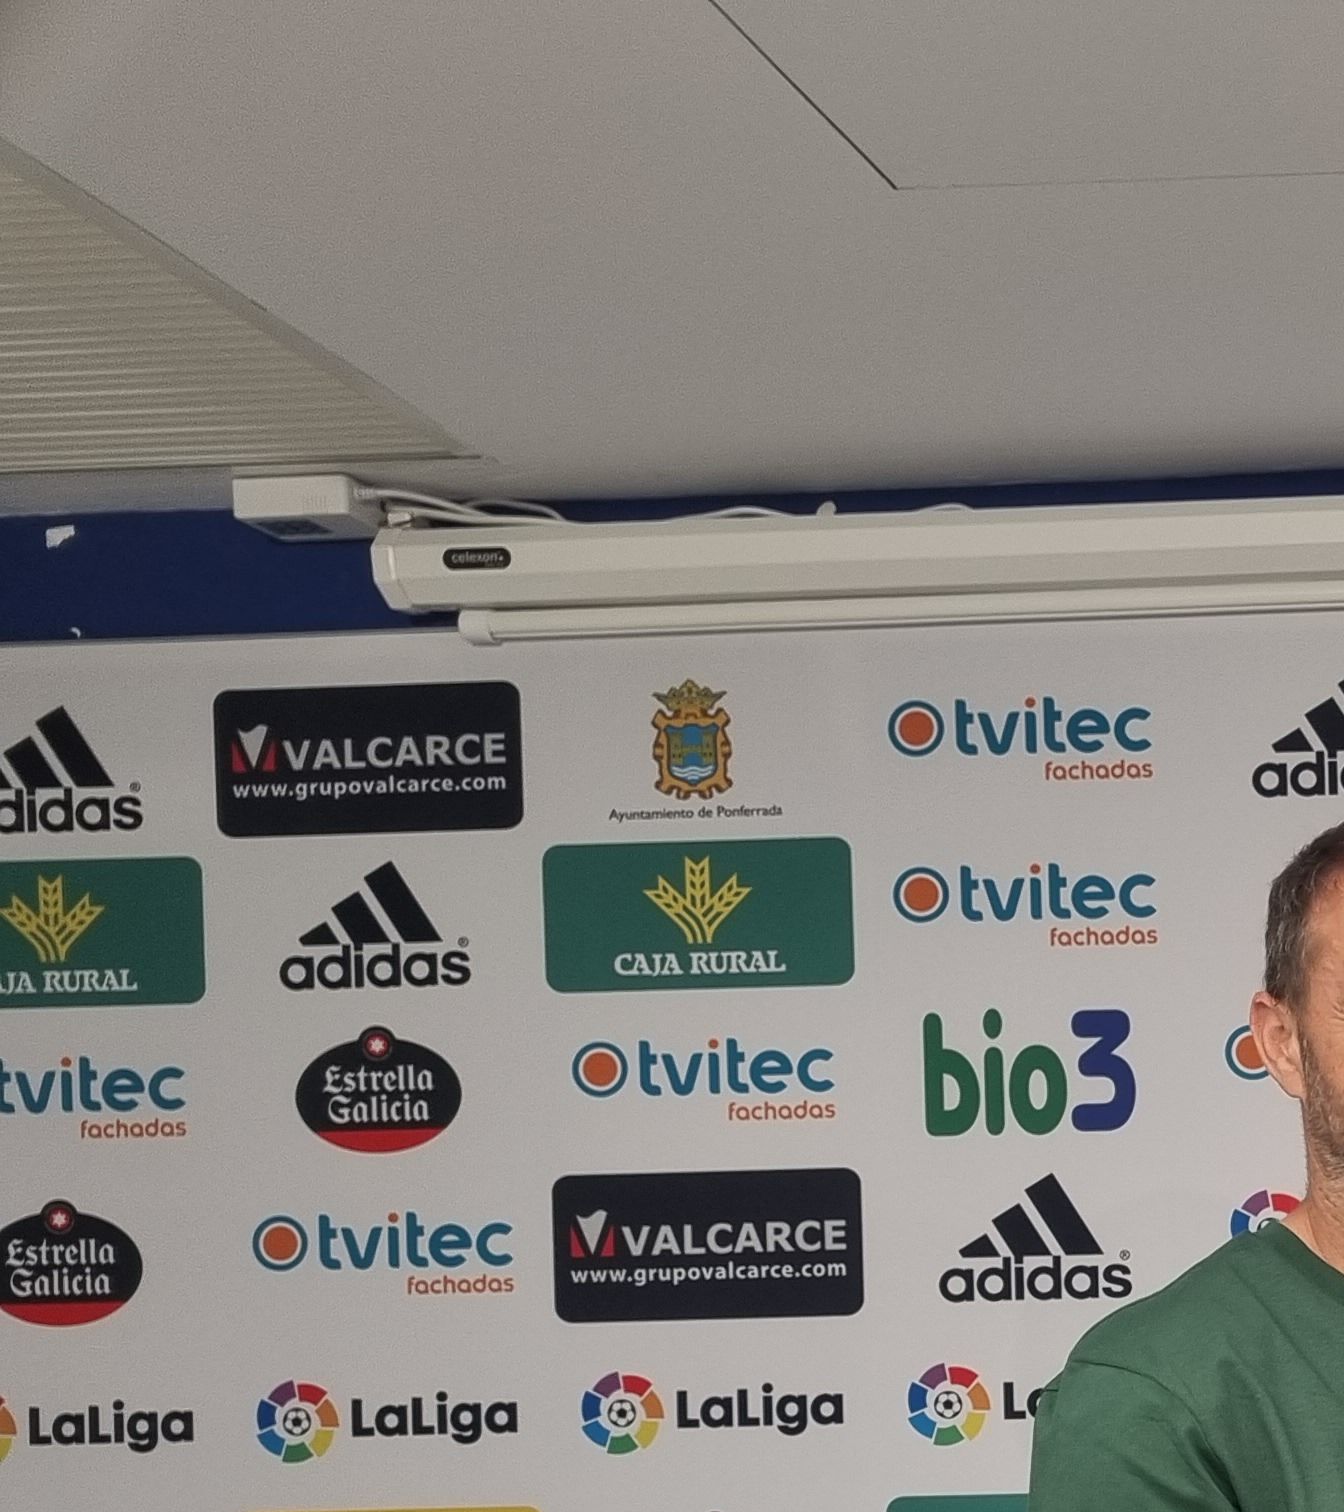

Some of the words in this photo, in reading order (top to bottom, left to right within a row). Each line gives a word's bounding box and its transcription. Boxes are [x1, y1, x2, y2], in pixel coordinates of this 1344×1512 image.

[451, 551, 498, 563] celexon
[954, 696, 1152, 755] tvitec
[283, 734, 506, 771] VALCARCE
[1044, 760, 1152, 781] fachadas
[233, 773, 506, 801] www.grupovalcarce.com
[609, 808, 694, 823] Ayuntamiento
[698, 805, 713, 819] de
[717, 803, 783, 819] Ponferrada
[959, 862, 1158, 922] tvitec
[1049, 926, 1158, 947] fachadas
[280, 942, 470, 990] adidas
[614, 952, 683, 977] CAJA
[690, 950, 785, 974] RURAL
[0, 971, 34, 996] JA
[44, 969, 137, 994] RURAL
[322, 1065, 433, 1094] Estrella
[638, 1038, 835, 1097] tvitec
[923, 1007, 1137, 1137] bio3
[0, 1056, 185, 1115] tvitec
[328, 1094, 430, 1126] Galicia
[727, 1100, 835, 1122] fachadas
[79, 1118, 186, 1140] fachadas
[6, 1238, 115, 1268] Estrella
[318, 1211, 513, 1271] tvitec
[622, 1219, 847, 1256] VALCARCE
[10, 1268, 111, 1300] Galicia
[406, 1273, 514, 1295] fachadas
[571, 1257, 847, 1287] www.grupovalcarce.com
[940, 1253, 1132, 1304] adidas
[352, 1392, 518, 1444] LaLiga
[676, 1383, 843, 1436] LaLiga
[28, 1401, 193, 1453] LaLiga
